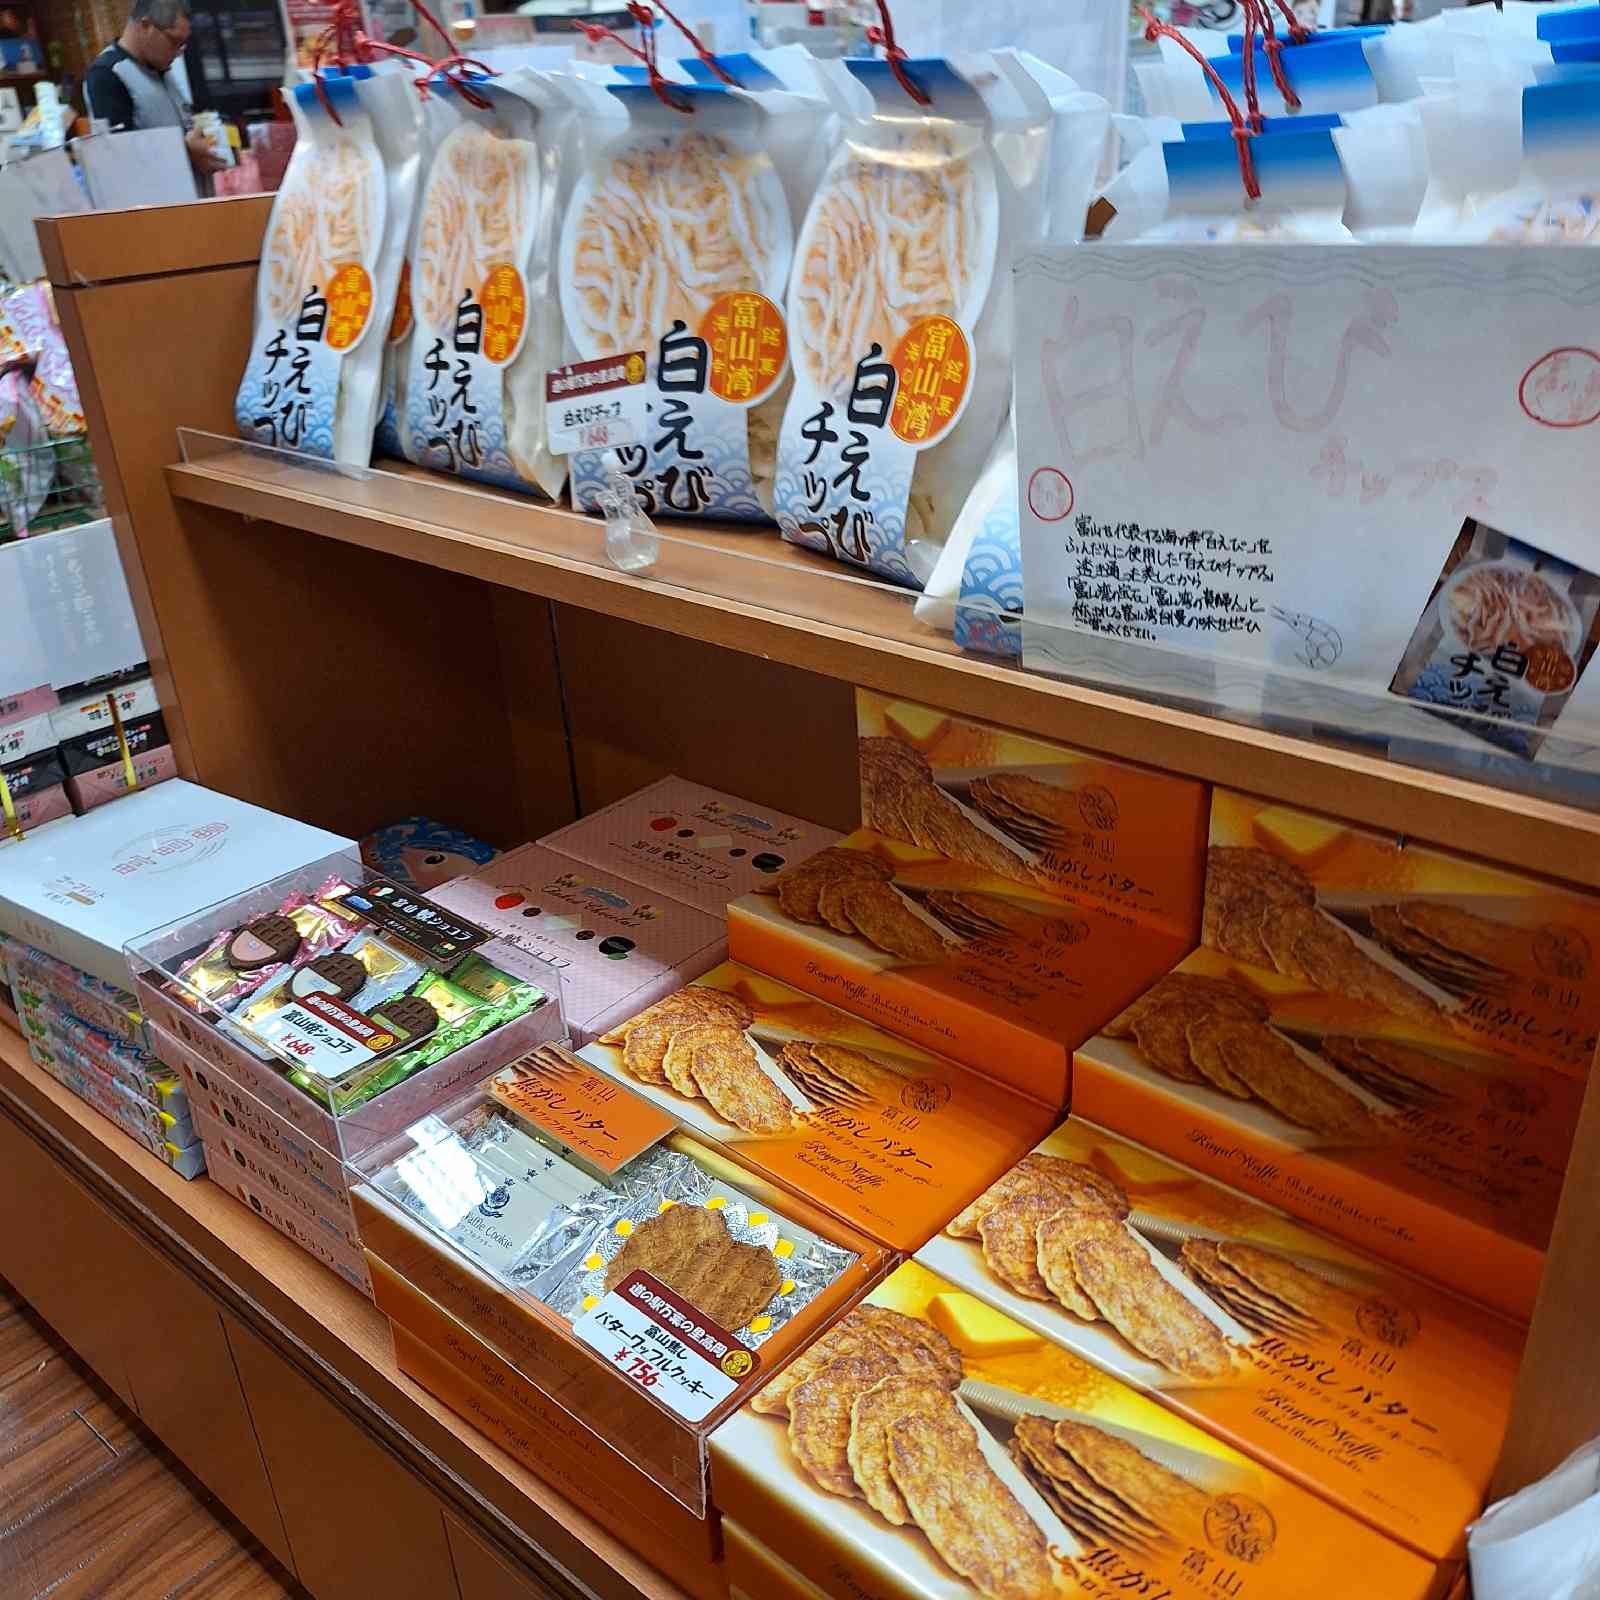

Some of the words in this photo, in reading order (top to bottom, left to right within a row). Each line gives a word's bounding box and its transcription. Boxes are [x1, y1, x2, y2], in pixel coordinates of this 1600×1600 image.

[281, 284, 329, 447] 白えび
[450, 287, 483, 469] 白えび
[723, 296, 762, 399] 富山湾
[900, 323, 954, 440] 富山湾
[1040, 279, 1402, 462] 白えび
[654, 318, 714, 514] 白えび
[829, 341, 897, 563] 白えび
[798, 401, 839, 559] チップ
[391, 897, 475, 941] 富山焼ショコラ
[280, 1008, 358, 1054] 富山焼ショコラ
[511, 1076, 619, 1142] 焦がしバター
[582, 1076, 617, 1102] 富山
[880, 1105, 921, 1131] 富山
[812, 1106, 934, 1169] 焦がしバター
[461, 1210, 487, 1231] affle
[484, 1225, 513, 1249] Cookie
[593, 1310, 715, 1401] バターワッフルクッキー
[627, 1281, 729, 1359] 道の駅万葉の里高岡
[643, 1323, 689, 1361] 富山焦し
[1339, 1337, 1397, 1374] 富山
[1252, 1336, 1440, 1434] 焦がしバター
[1257, 1387, 1330, 1427] Royal
[1324, 1421, 1390, 1462] Waffle
[1180, 1546, 1243, 1597] 富山
